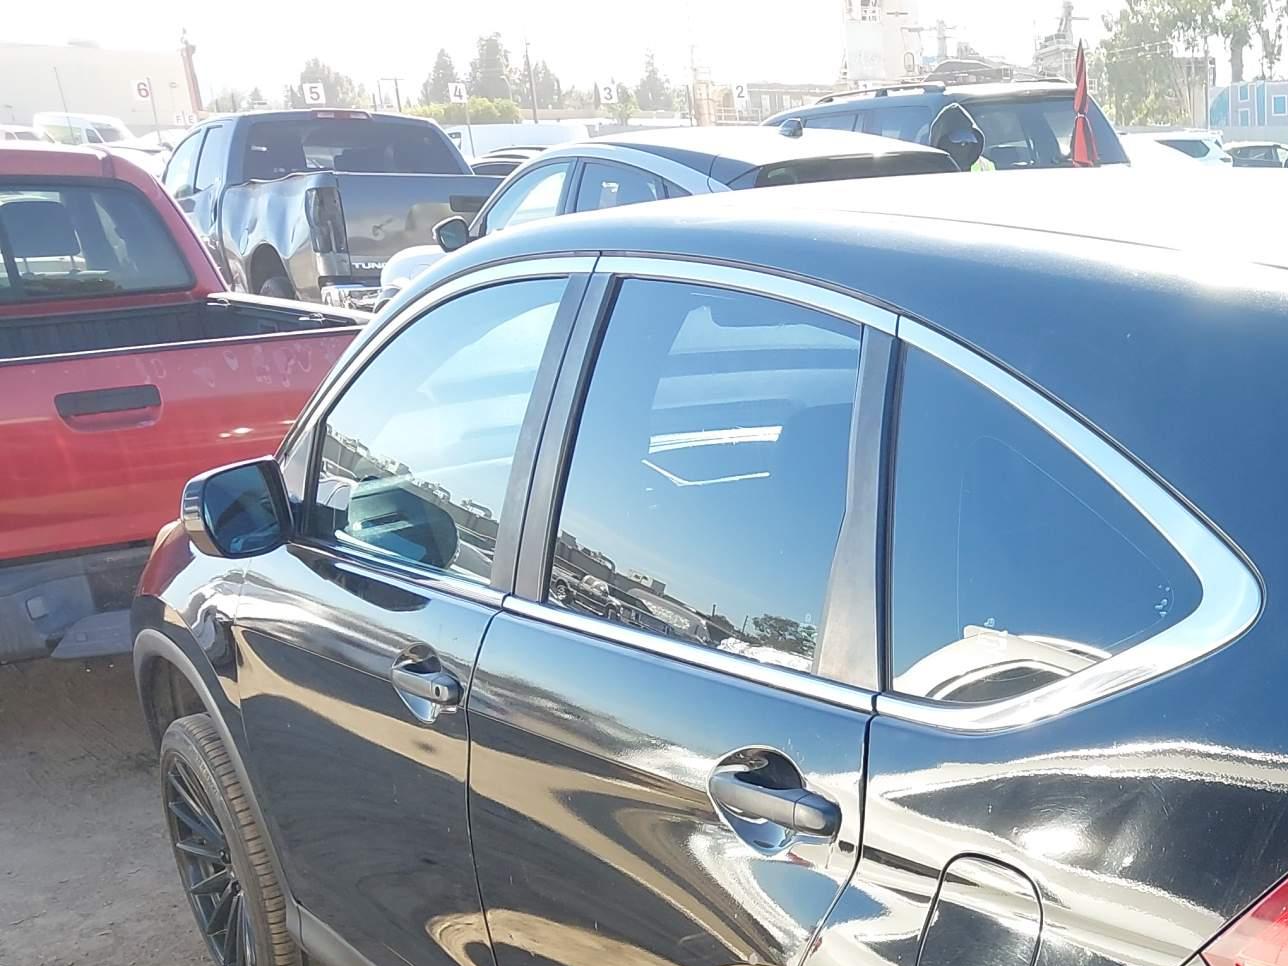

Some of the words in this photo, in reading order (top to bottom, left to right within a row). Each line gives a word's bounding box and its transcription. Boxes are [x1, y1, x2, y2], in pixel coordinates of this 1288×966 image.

[137, 82, 149, 98] 6
[309, 86, 320, 101] 5
[453, 85, 463, 100] 4
[603, 86, 613, 100] 3
[735, 84, 745, 99] 2
